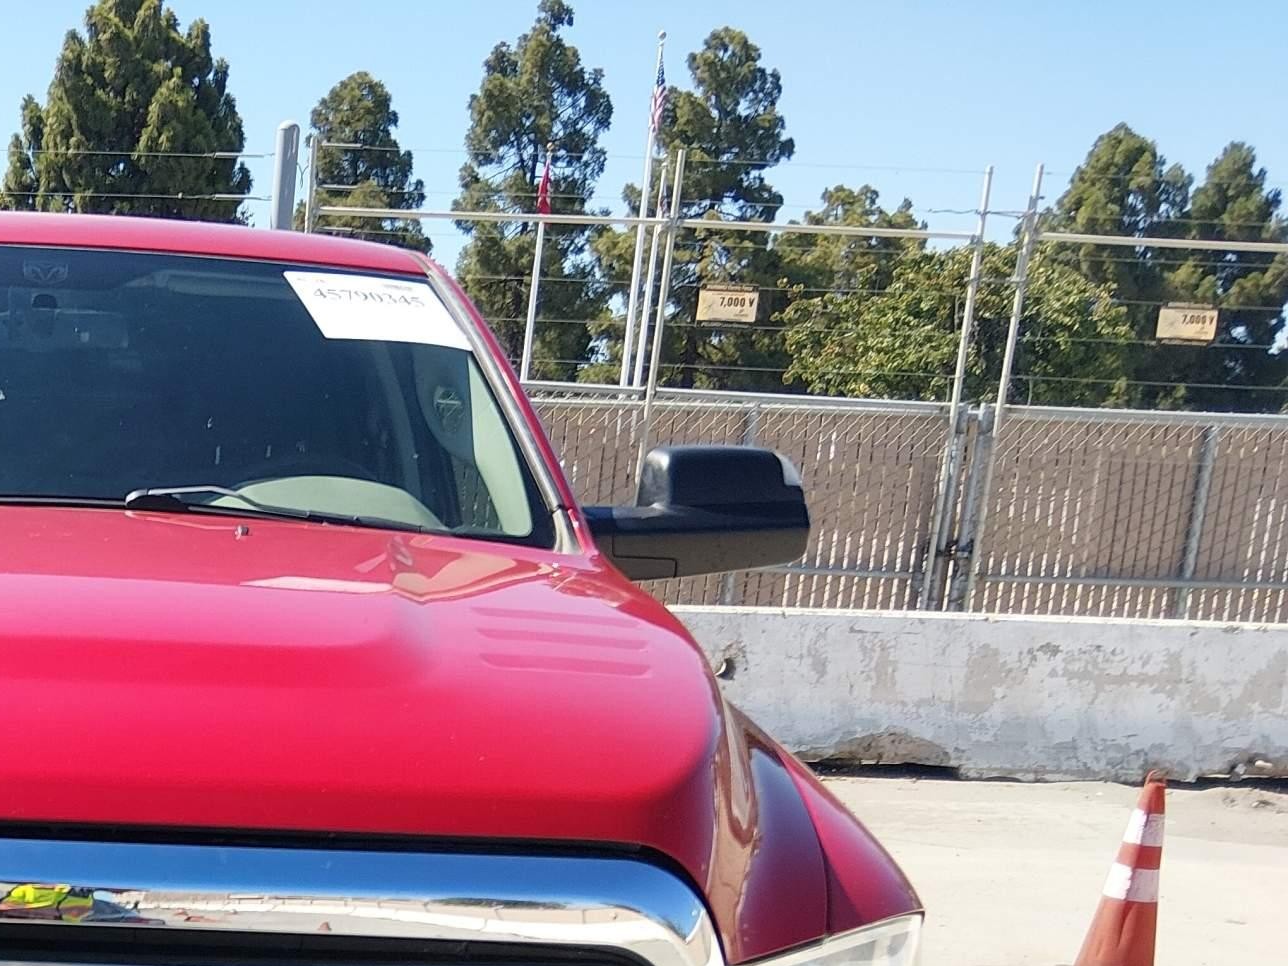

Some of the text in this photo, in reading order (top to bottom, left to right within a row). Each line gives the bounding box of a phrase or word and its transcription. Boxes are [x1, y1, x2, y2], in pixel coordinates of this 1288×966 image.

[312, 287, 425, 308] 45790345
[720, 296, 755, 308] 7,000 V
[1182, 314, 1207, 325] 7,000
